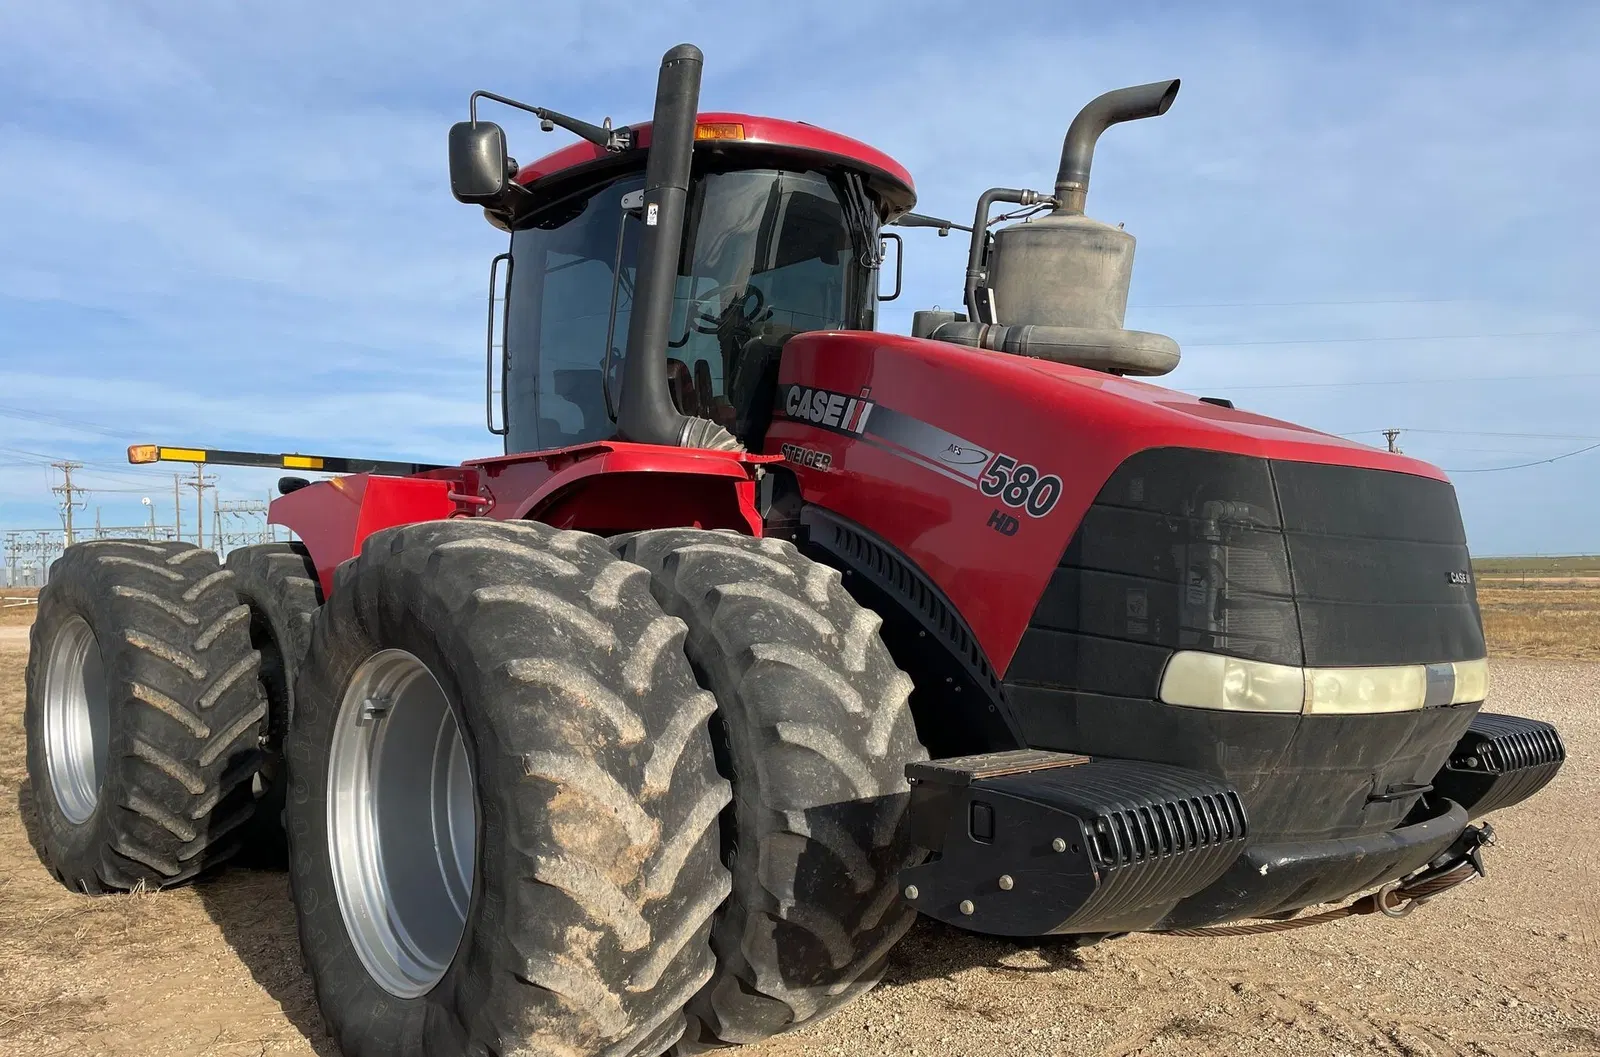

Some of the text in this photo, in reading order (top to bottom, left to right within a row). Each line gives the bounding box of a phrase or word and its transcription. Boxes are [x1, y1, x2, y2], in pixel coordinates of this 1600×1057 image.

[786, 385, 846, 427] CASE
[781, 443, 832, 472] STEIGER
[947, 443, 963, 456] AFS
[980, 452, 1063, 518] 580
[986, 508, 1020, 536] HD
[1450, 571, 1467, 584] CASE
